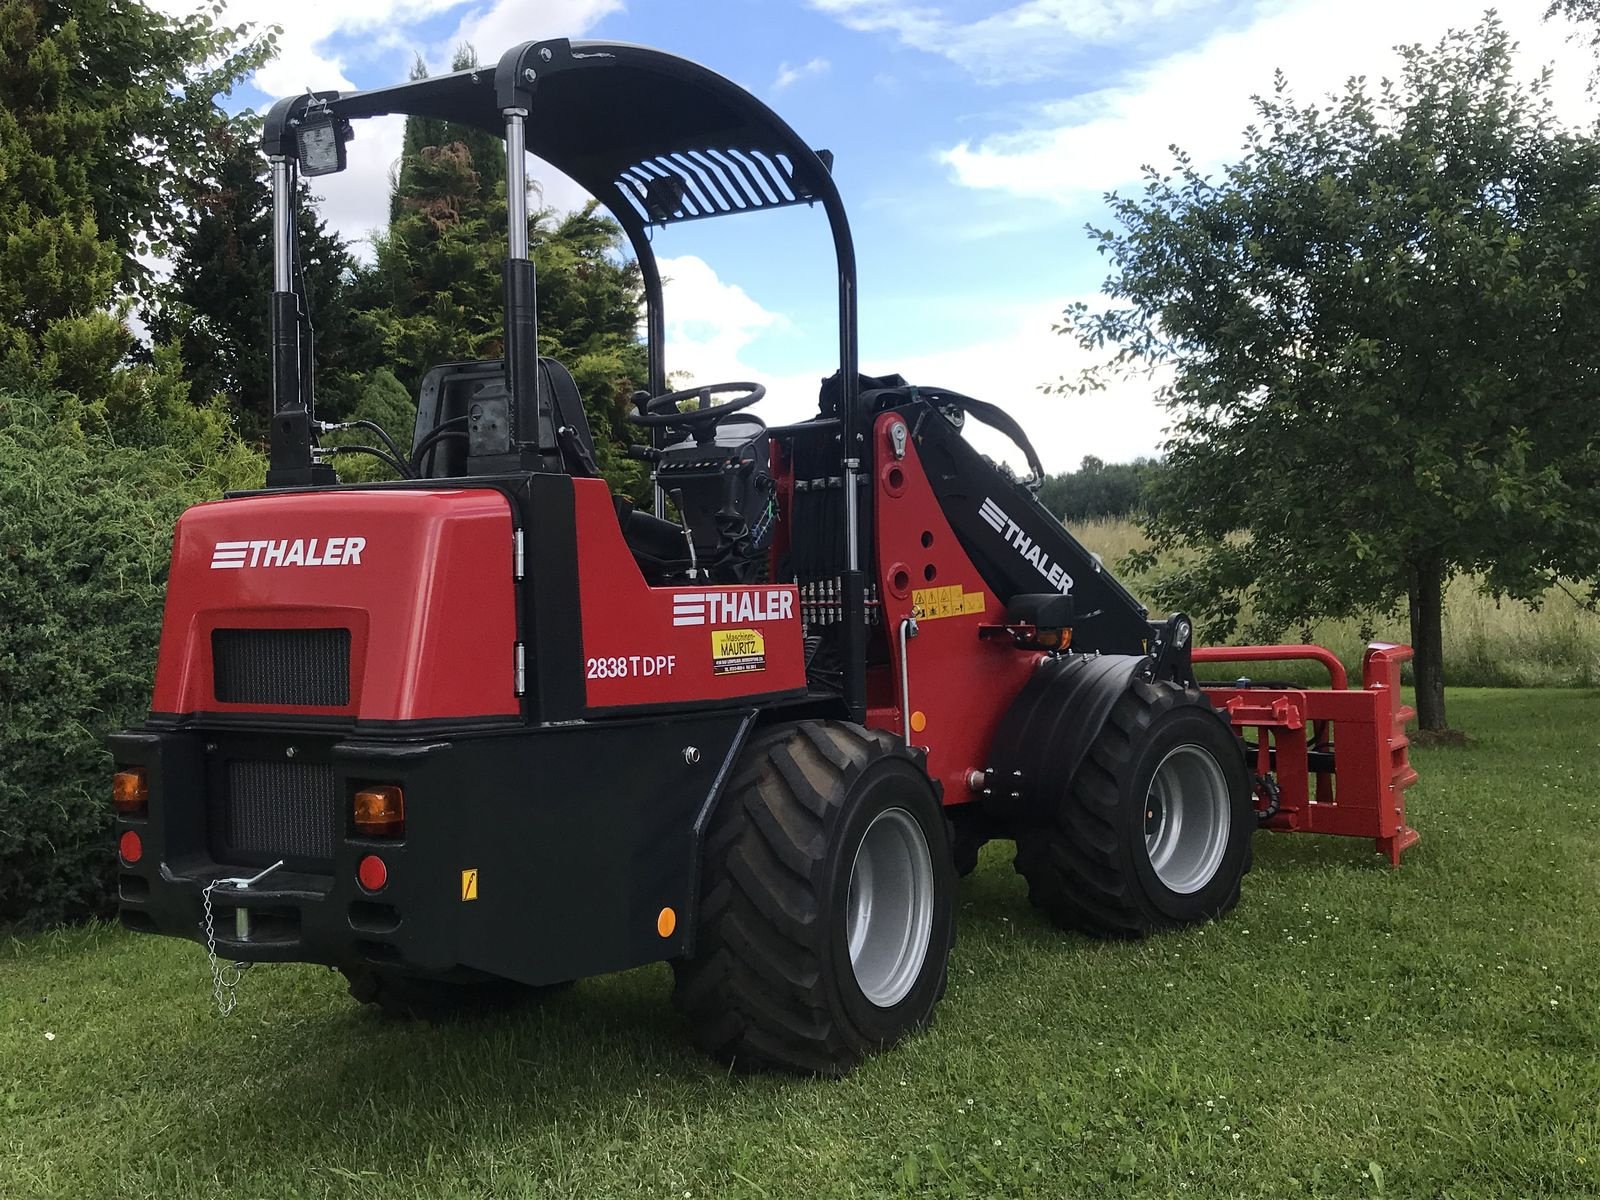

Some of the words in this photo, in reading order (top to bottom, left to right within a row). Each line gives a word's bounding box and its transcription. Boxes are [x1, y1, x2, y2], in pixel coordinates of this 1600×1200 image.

[249, 537, 366, 568] THALER
[1004, 518, 1074, 595] THALER
[705, 590, 794, 624] THALER
[720, 641, 756, 656] MAURITZ
